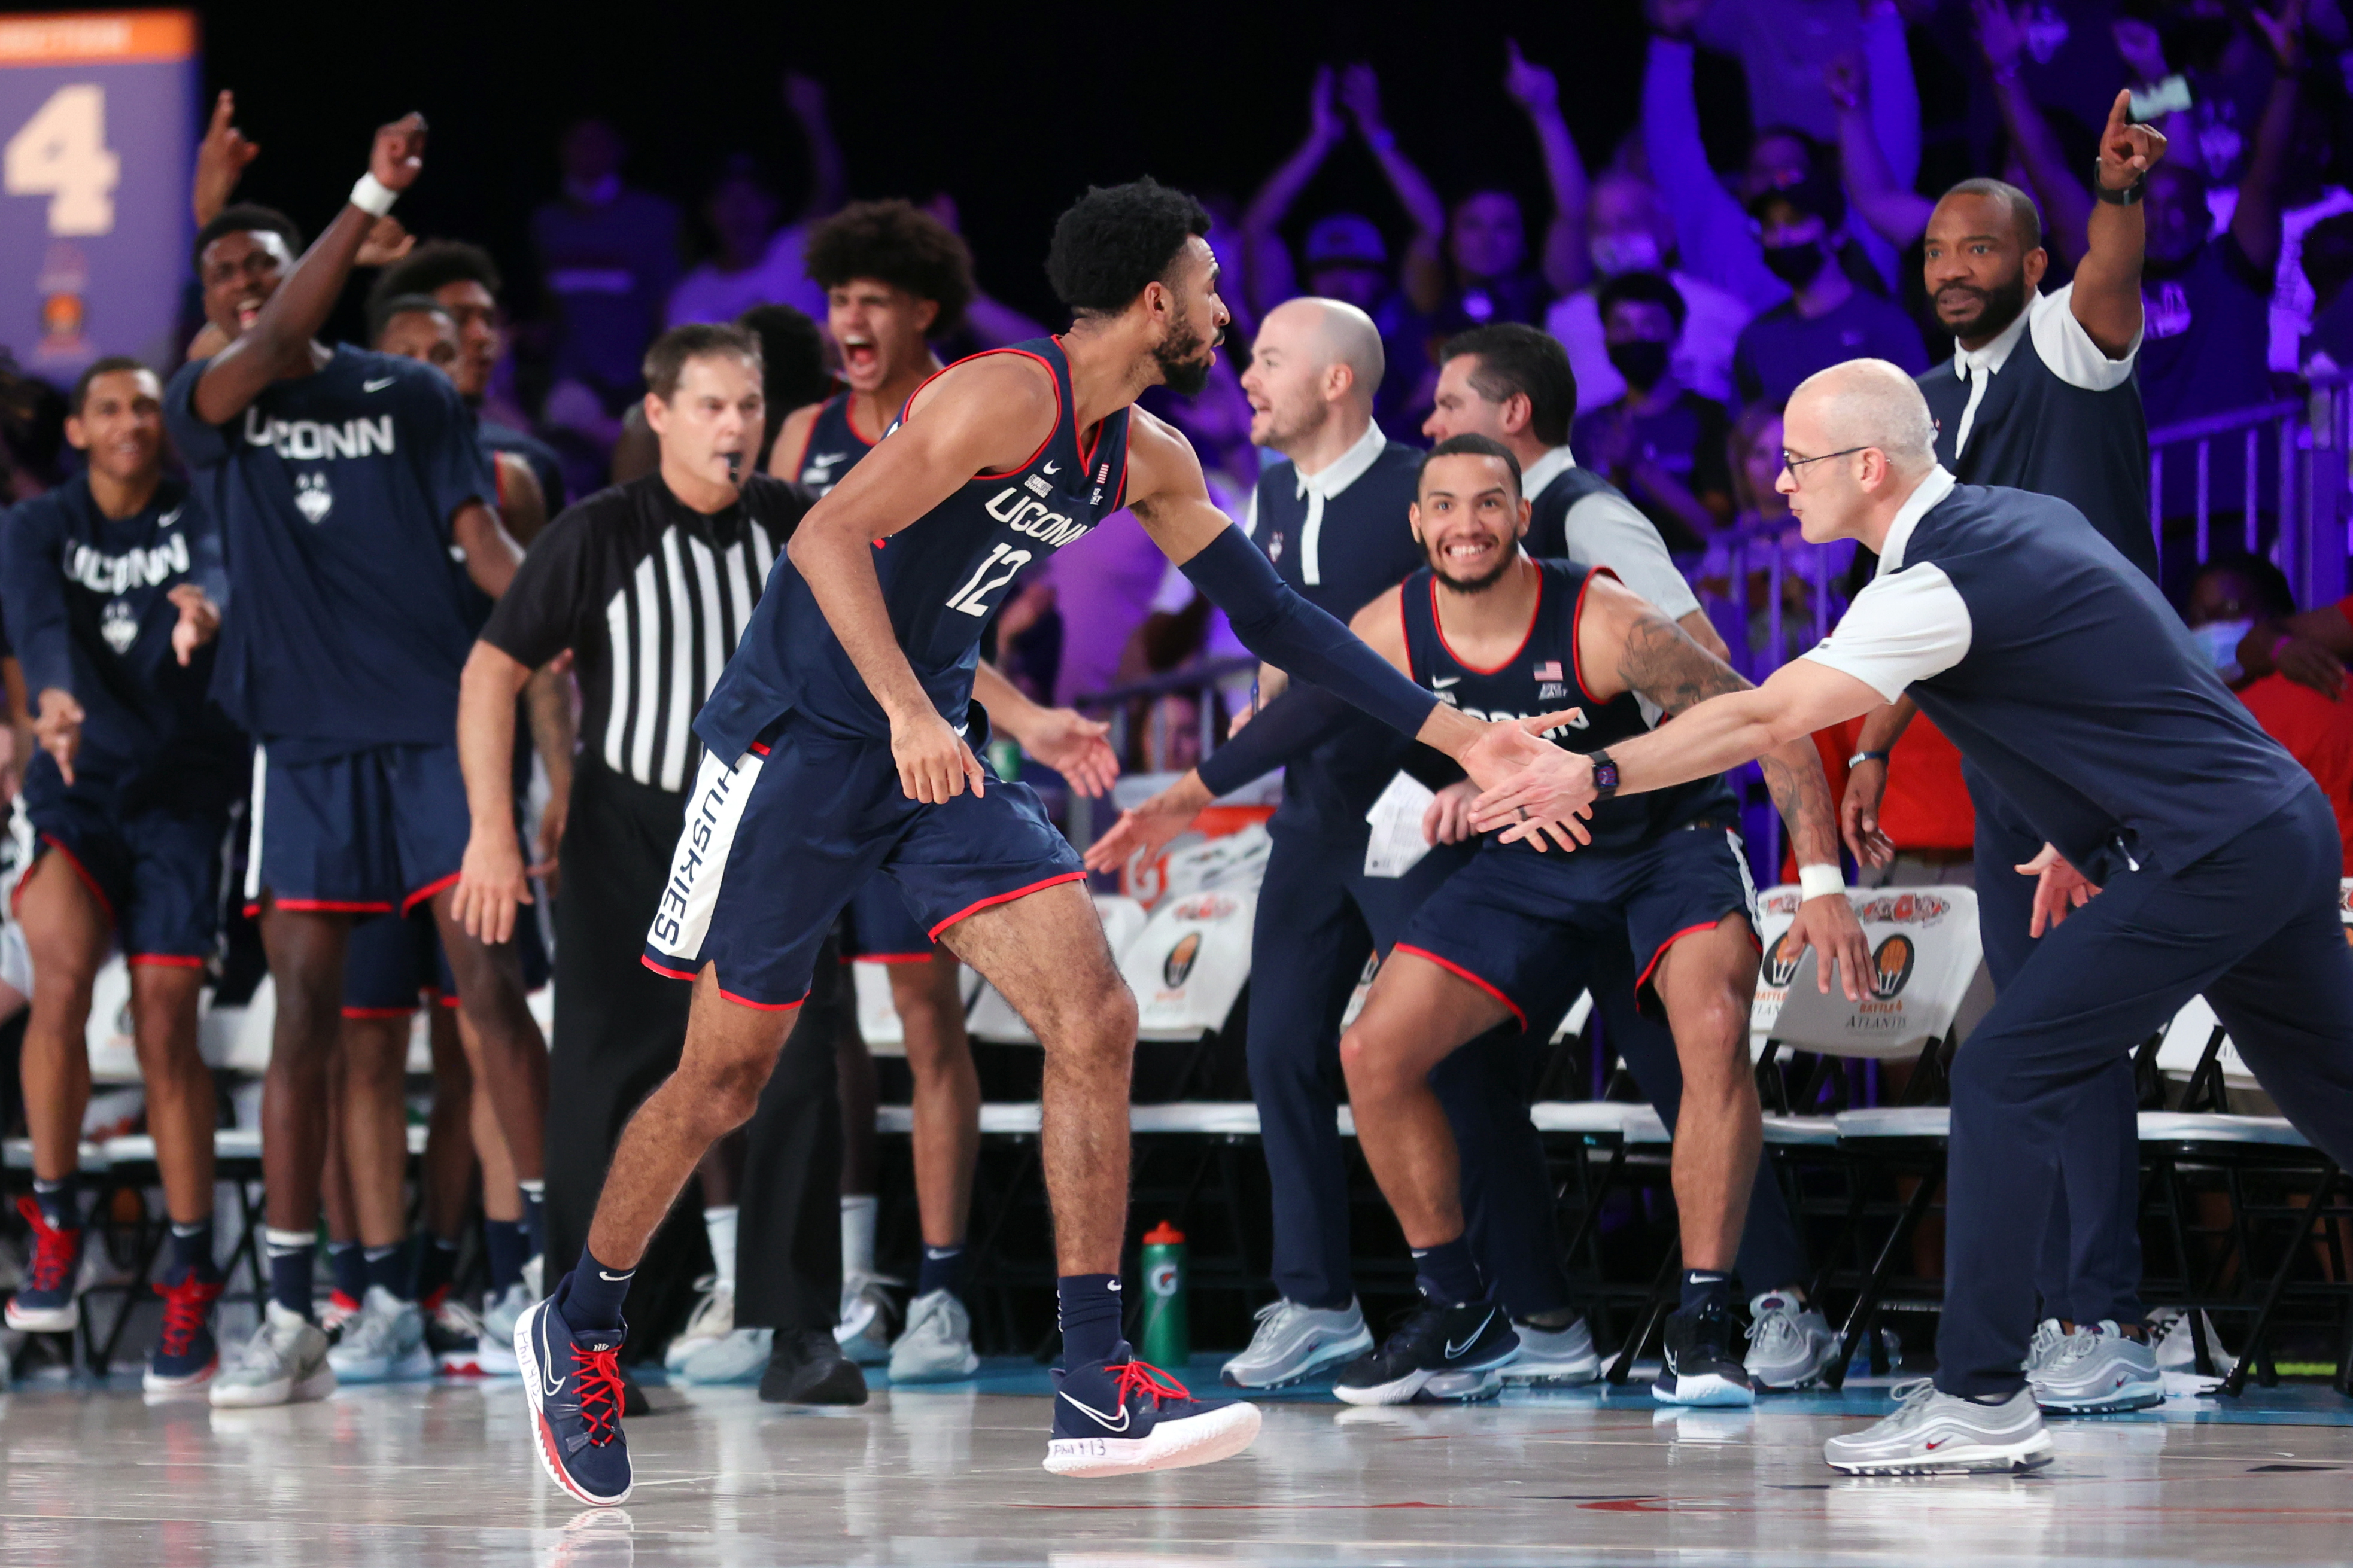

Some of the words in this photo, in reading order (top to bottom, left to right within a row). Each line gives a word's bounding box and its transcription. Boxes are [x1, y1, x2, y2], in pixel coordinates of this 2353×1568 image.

[3, 83, 120, 235] 4
[244, 406, 396, 460] UCONN
[985, 487, 1095, 547] UCONN
[63, 532, 190, 595] UCONN
[946, 543, 1032, 617] 12
[655, 766, 739, 946] HUSKIES
[1150, 1263, 1178, 1298] G
[1054, 1444, 1074, 1457] Phil
